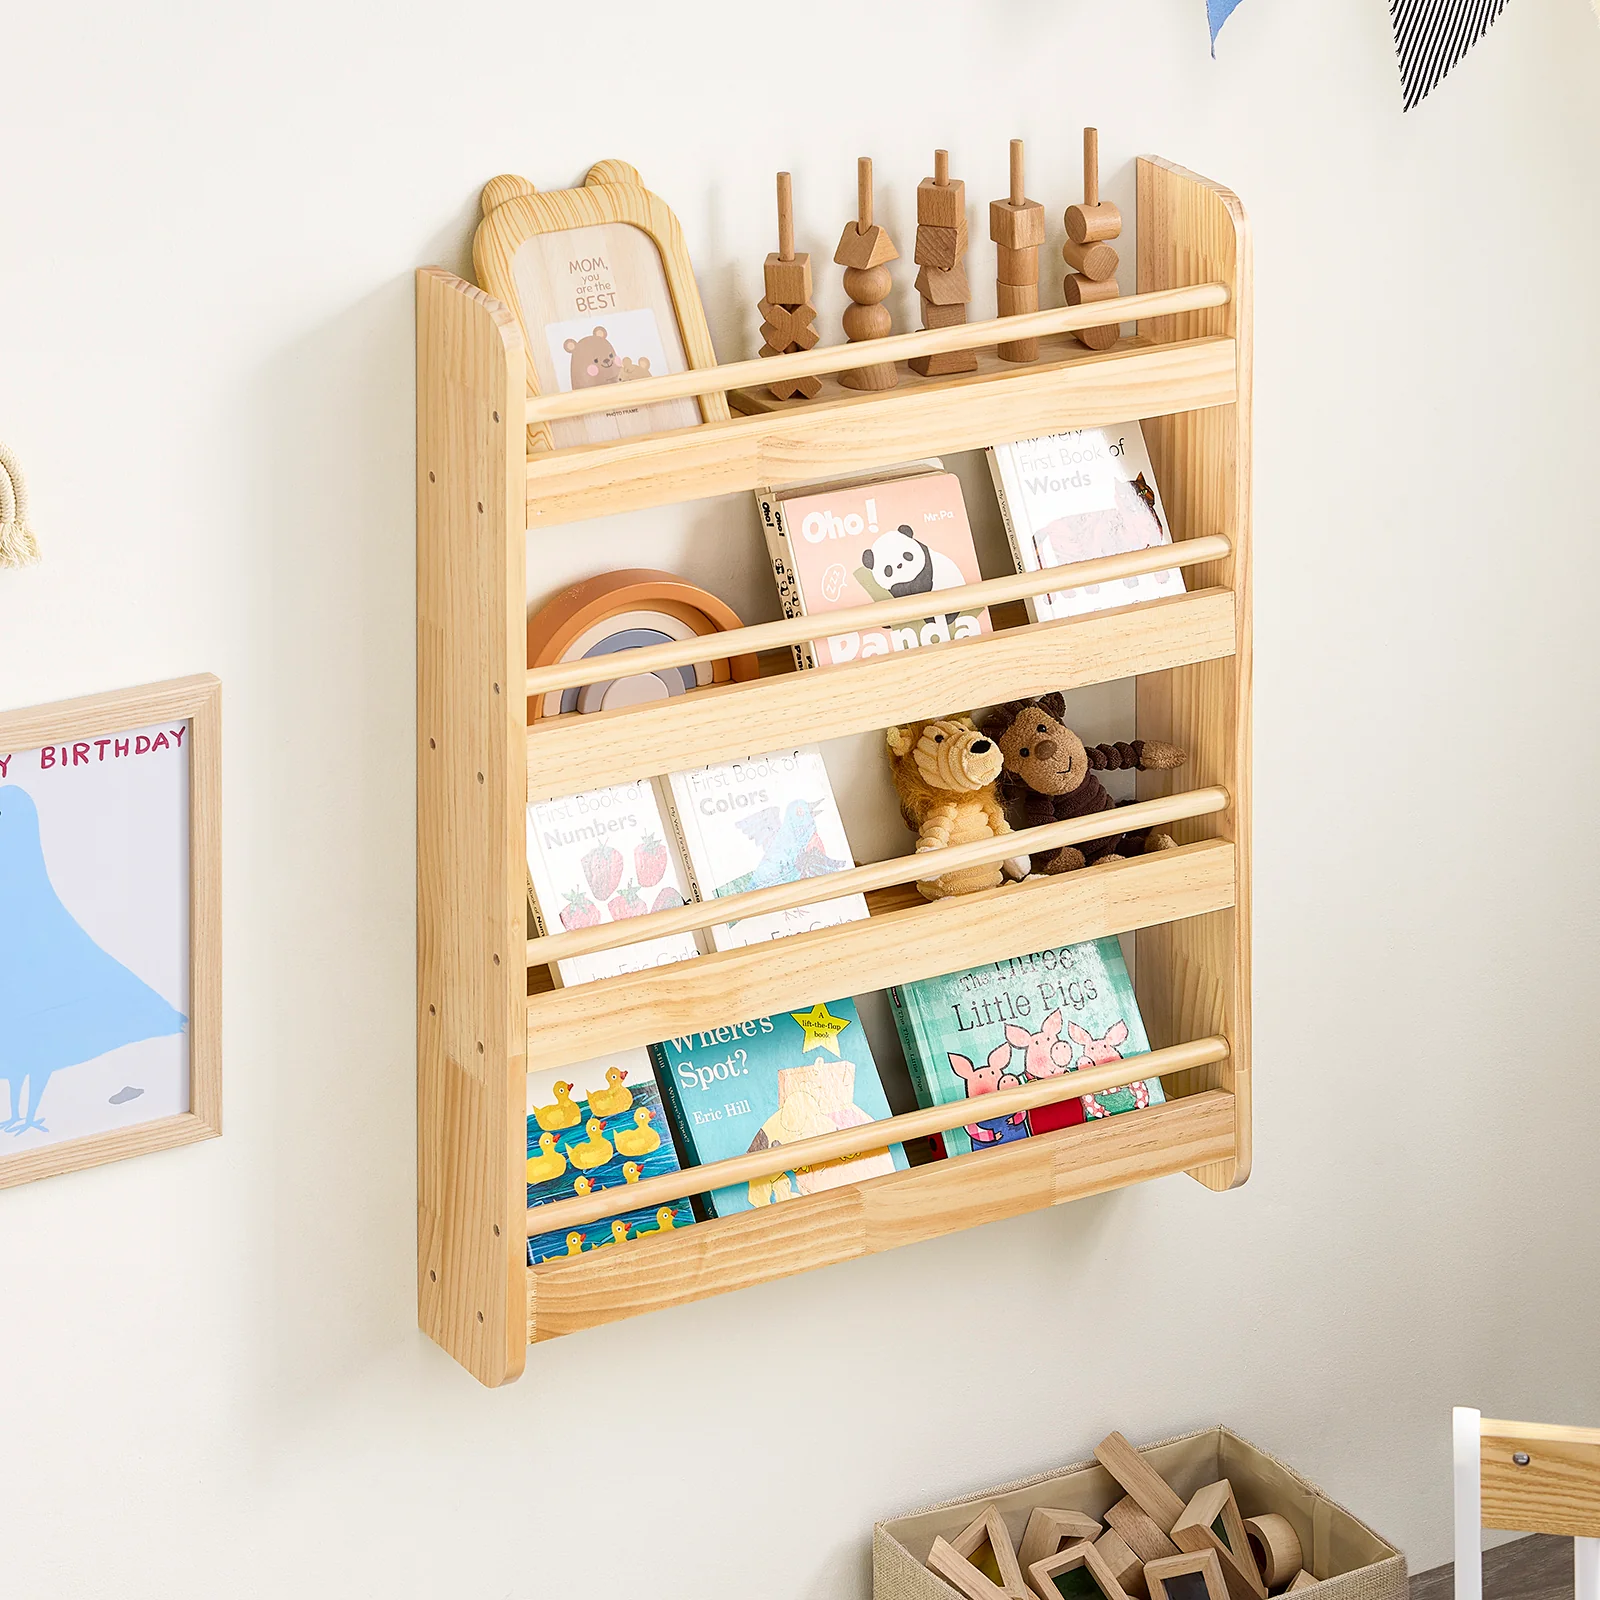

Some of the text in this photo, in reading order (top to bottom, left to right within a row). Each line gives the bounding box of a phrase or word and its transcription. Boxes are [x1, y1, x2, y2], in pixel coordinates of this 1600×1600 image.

[569, 256, 608, 274] MOM,
[576, 281, 611, 294] are the
[581, 273, 600, 285] you
[575, 292, 616, 312] BEST
[1019, 437, 1126, 473] First Book of
[1024, 470, 1092, 496] Words
[762, 501, 775, 527] Oho!
[775, 511, 786, 537] Oho!
[801, 498, 880, 544] Oho!
[923, 509, 954, 523] Mr.Pa
[827, 614, 982, 665] Panda
[794, 645, 804, 671] Pan
[40, 726, 186, 769] BIRTHDAY
[691, 750, 800, 793] First Book of
[536, 779, 645, 825] First Book of
[699, 787, 769, 816] Colors
[543, 813, 638, 849] Numbers
[960, 973, 990, 992] The
[952, 976, 1099, 1032] Little Pigs
[670, 1016, 774, 1053] Wheres
[802, 1020, 841, 1031] lift-the-flap
[677, 1048, 750, 1091] Spot?
[692, 1099, 751, 1125] Eric Hill
